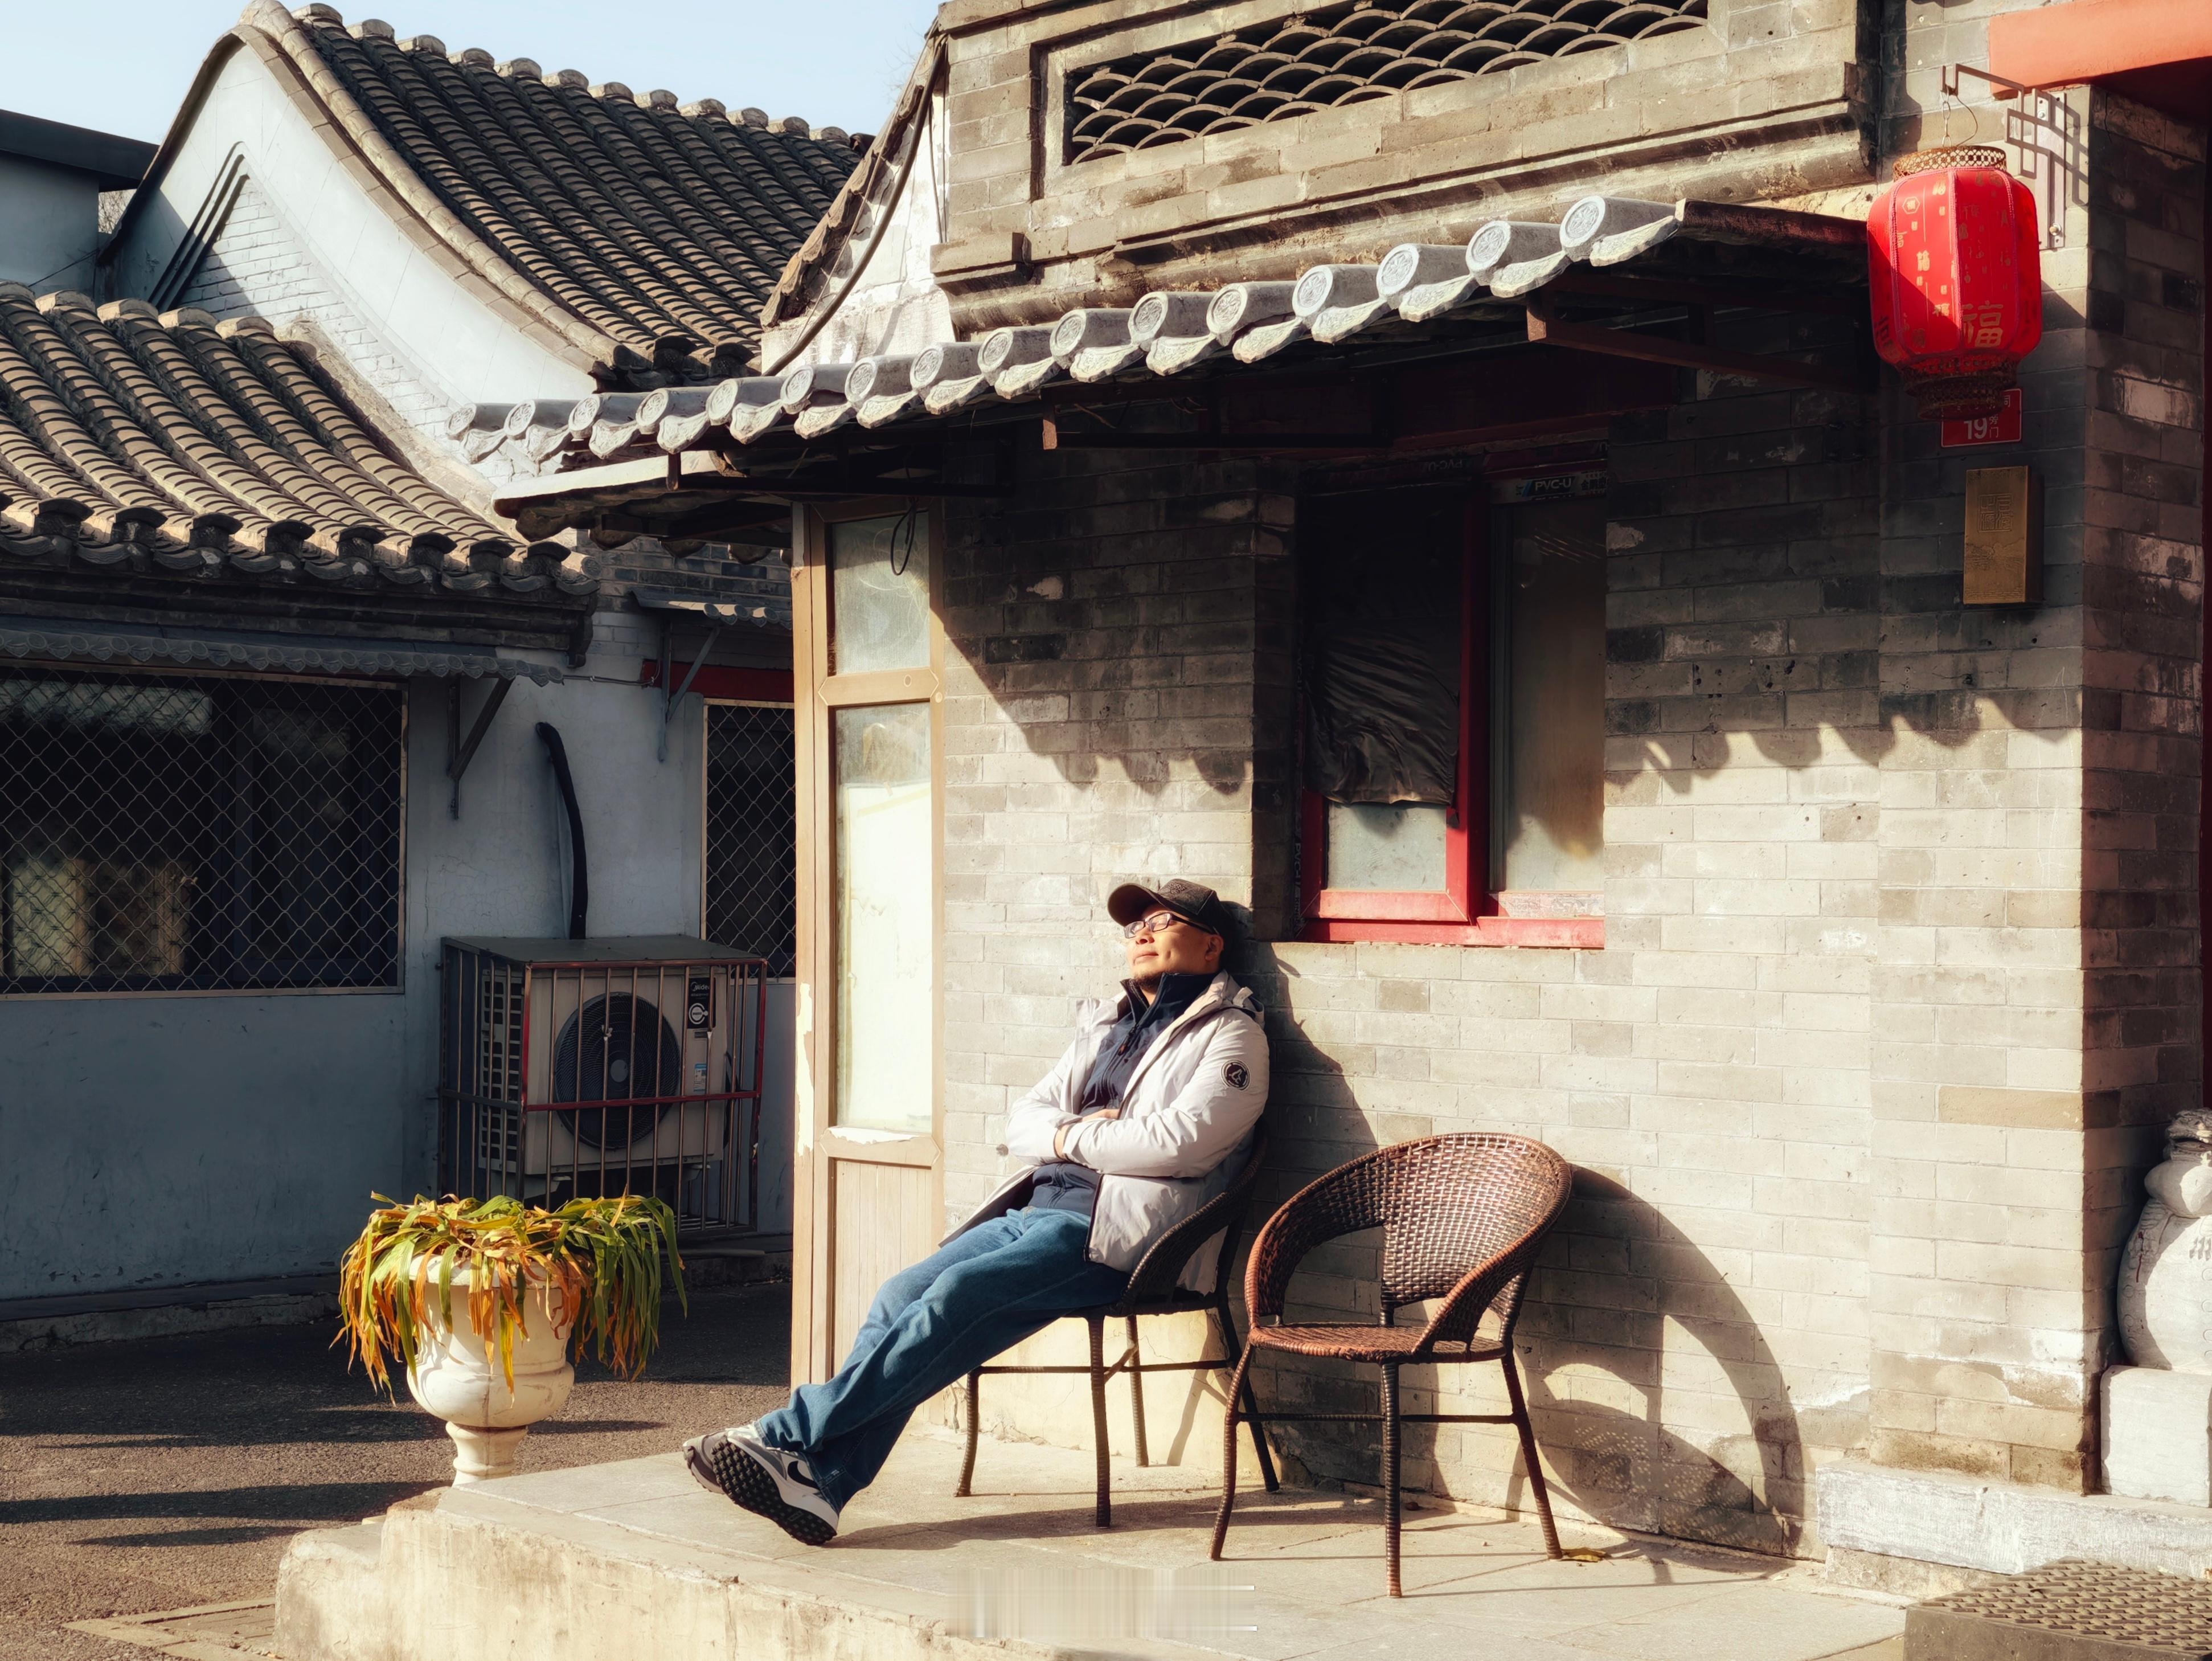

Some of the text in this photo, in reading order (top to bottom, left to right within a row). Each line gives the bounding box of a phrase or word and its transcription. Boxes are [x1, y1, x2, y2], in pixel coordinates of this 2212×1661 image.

[1961, 300, 2004, 347] 福
[1964, 417, 1988, 440] 19
[1428, 459, 1463, 472] PVC-U
[1535, 478, 1572, 492] PVC-U
